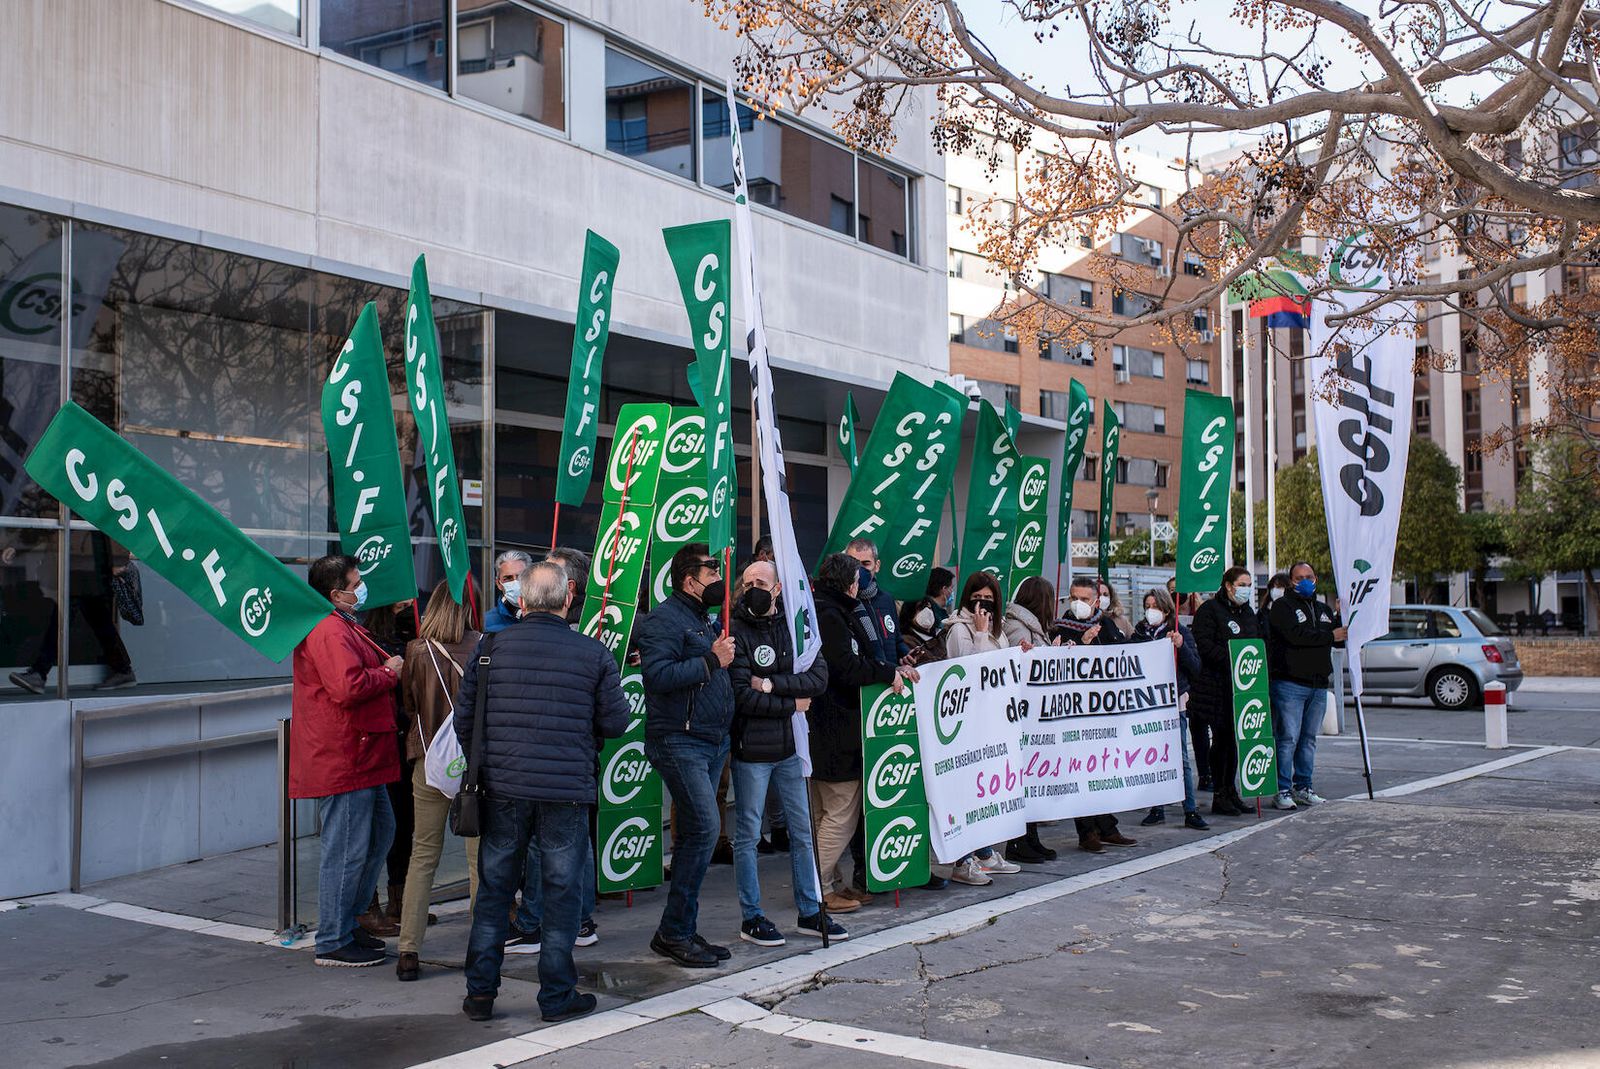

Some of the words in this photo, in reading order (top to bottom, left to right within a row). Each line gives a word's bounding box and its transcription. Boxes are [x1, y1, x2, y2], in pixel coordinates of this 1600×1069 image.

[669, 433, 706, 454] CSI
[1024, 478, 1046, 496] CSIF
[1020, 535, 1042, 553] CSIF
[980, 666, 1006, 690] Por
[1239, 659, 1263, 675] CSIF
[940, 687, 971, 719] CSIF
[1040, 692, 1084, 718] LABOR
[1089, 682, 1177, 712] DOCENTE
[876, 703, 917, 728] CSIF
[1243, 712, 1267, 730] CSIF
[1131, 721, 1163, 736] BAJADA
[878, 762, 921, 787] CSIF
[1247, 758, 1272, 775] CSIF
[1030, 785, 1037, 798] DE
[1038, 785, 1045, 797] LA
[1088, 775, 1124, 792] REDUCCIÓN
[1124, 772, 1156, 787] HORARIO
[612, 834, 656, 860] CSIF
[880, 833, 922, 860] CSIF
